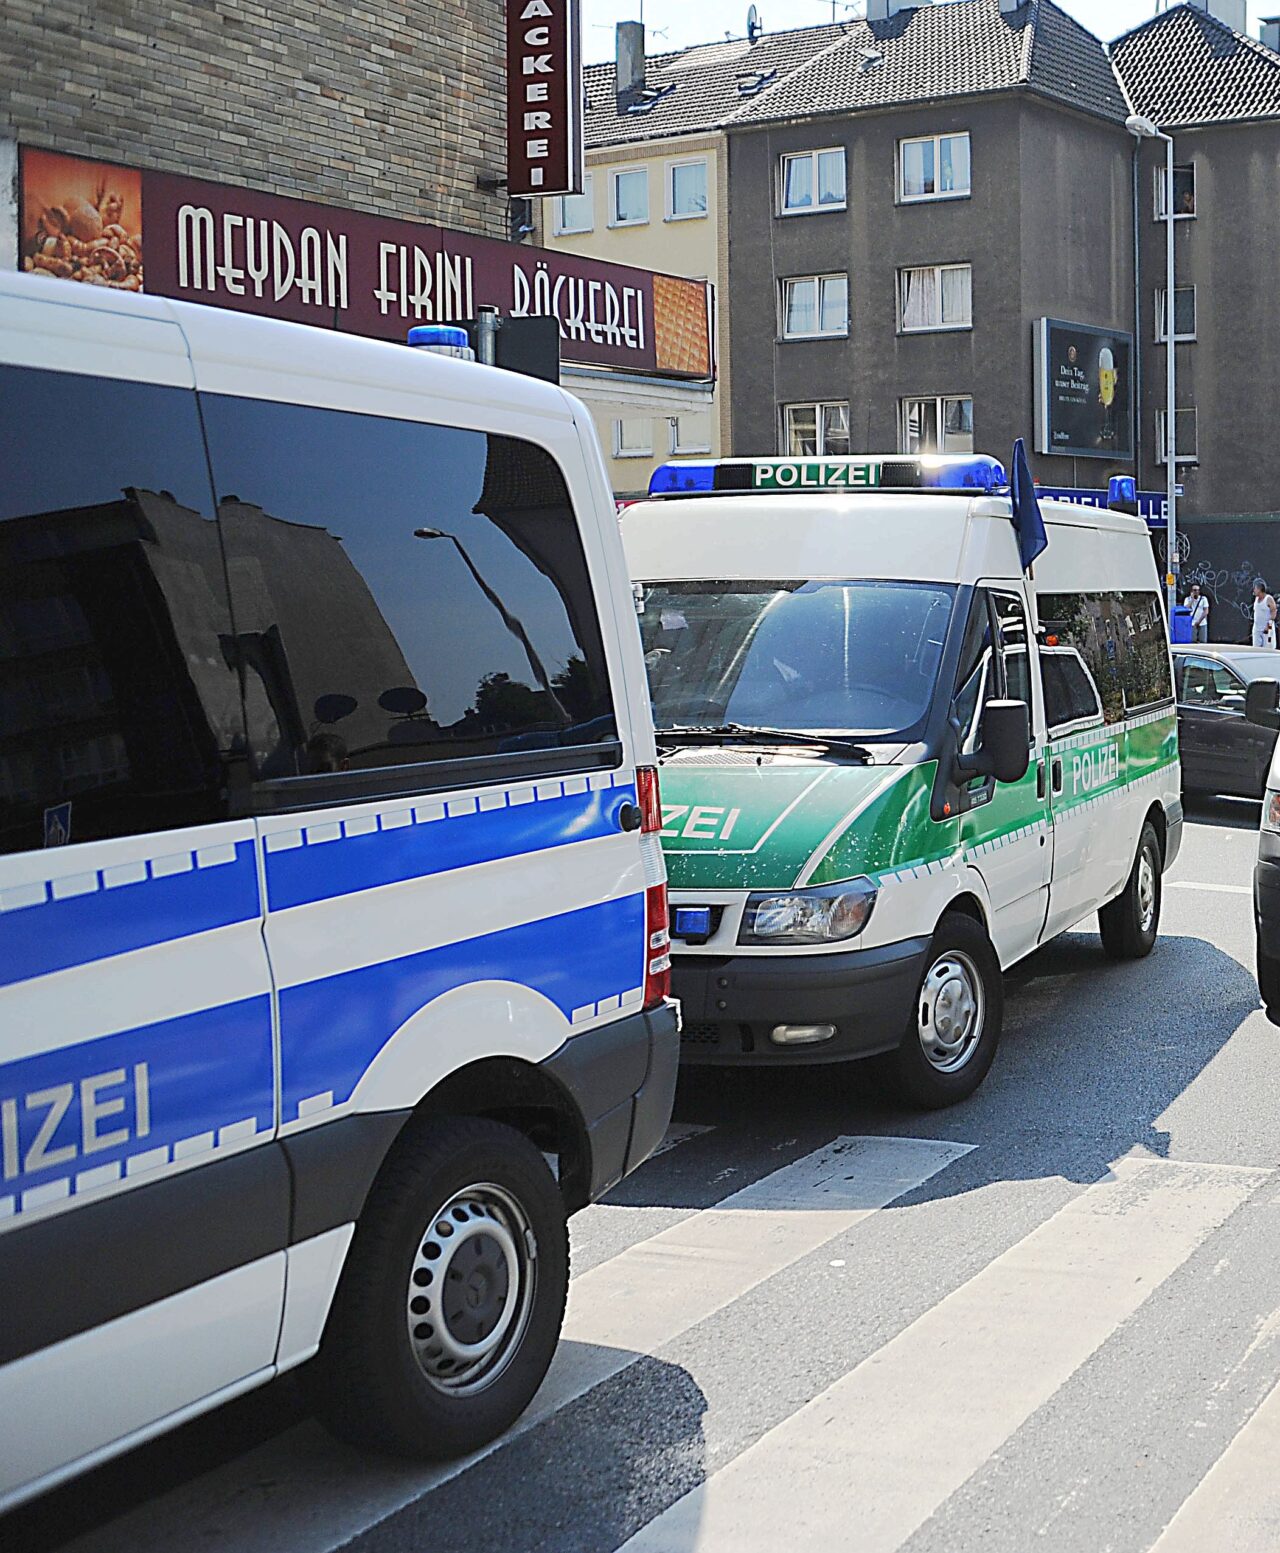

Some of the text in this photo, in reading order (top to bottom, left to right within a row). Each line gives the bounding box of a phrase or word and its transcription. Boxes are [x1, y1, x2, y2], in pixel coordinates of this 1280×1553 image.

[177, 204, 348, 309] MEYDAN
[373, 241, 474, 322] FIRINI
[755, 463, 876, 486] POLIZEI
[1073, 742, 1119, 795] POLIZEI
